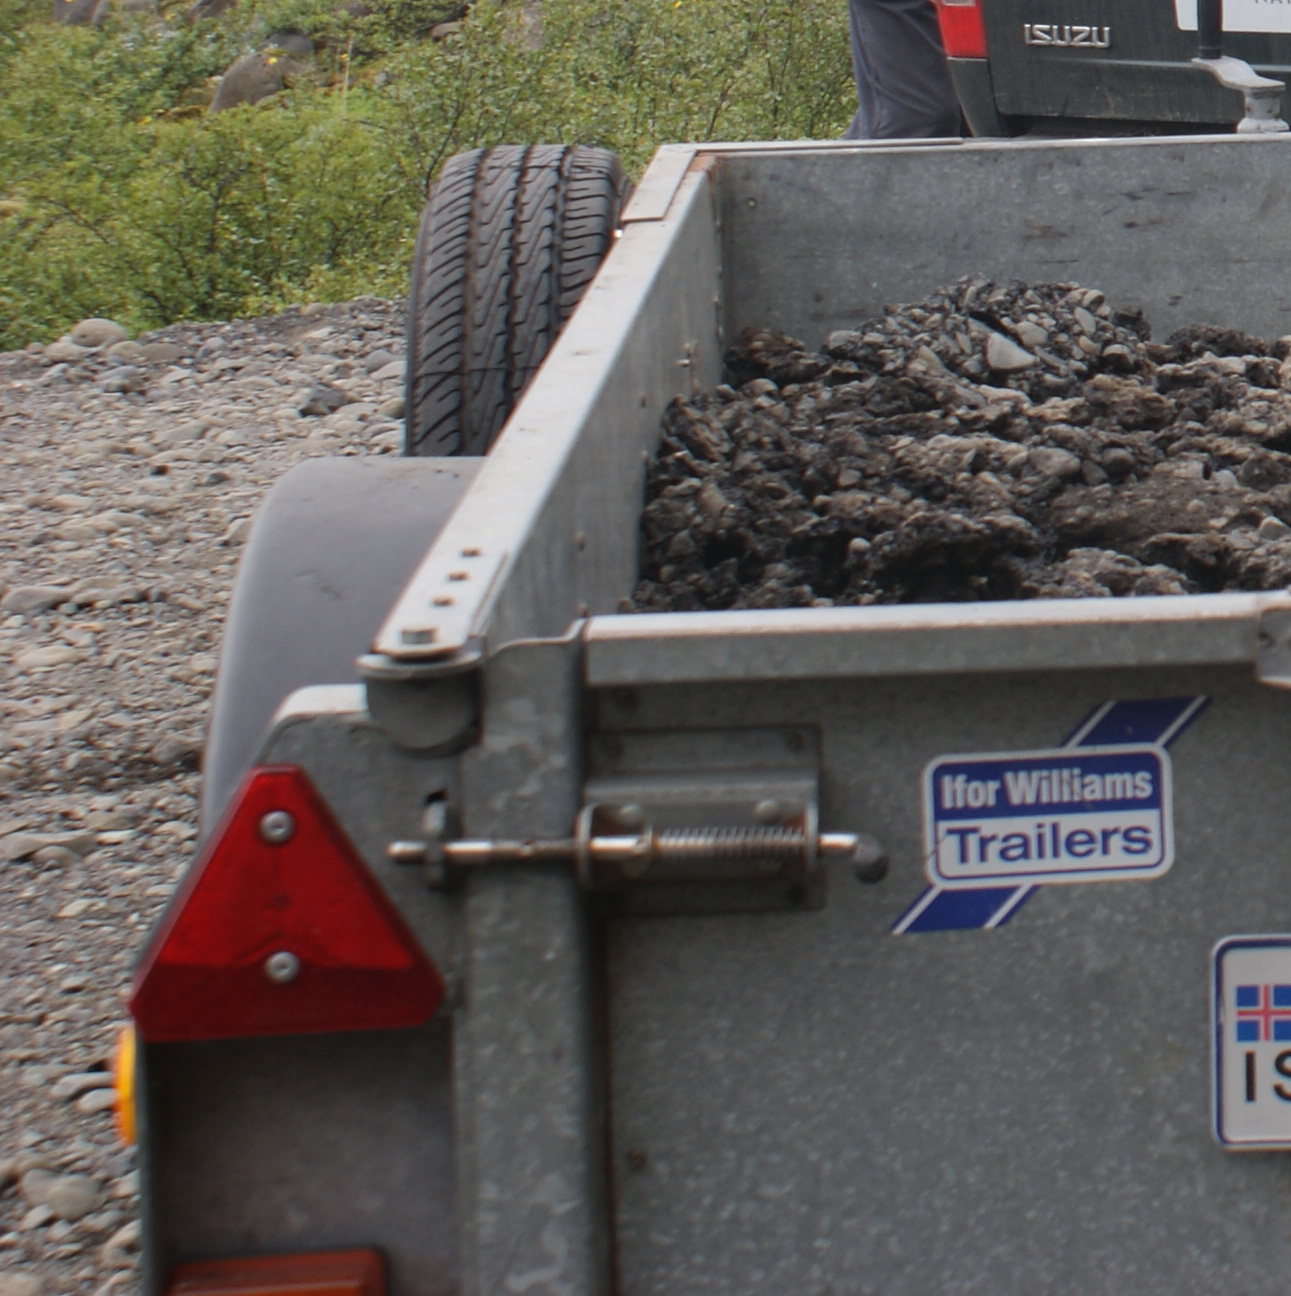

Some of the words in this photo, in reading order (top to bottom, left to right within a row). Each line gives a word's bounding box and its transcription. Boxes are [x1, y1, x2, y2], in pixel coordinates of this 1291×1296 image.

[1024, 23, 1111, 48] ISUZU
[939, 773, 1001, 810] Ifor
[1003, 767, 1154, 805] Williams
[946, 821, 1153, 865] Trailers
